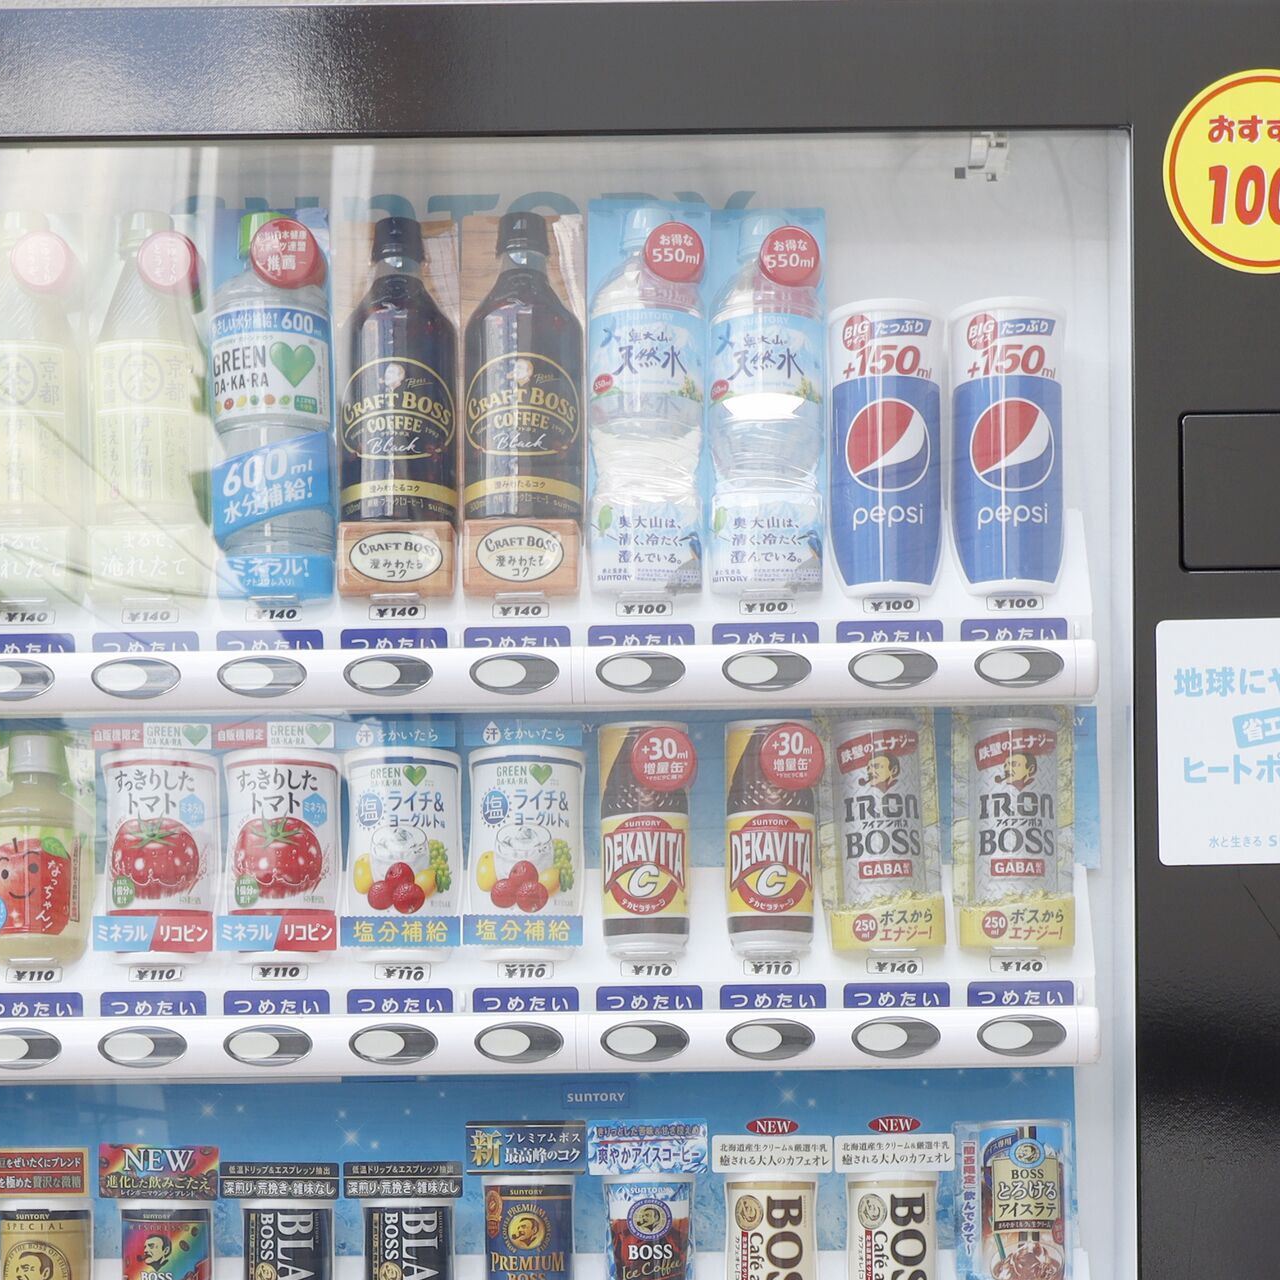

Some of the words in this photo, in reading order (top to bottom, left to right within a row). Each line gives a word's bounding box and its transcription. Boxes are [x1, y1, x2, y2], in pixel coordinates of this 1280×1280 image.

[660, 234, 693, 247] お得な
[774, 239, 807, 252] お得な
[652, 249, 699, 265] 550ml
[767, 253, 814, 268] 550ml
[843, 320, 870, 339] BIG
[876, 320, 924, 335] たっぷり
[968, 319, 995, 339] BIG
[1001, 320, 1049, 335] たっぷり
[213, 346, 266, 377] GREEN
[344, 393, 398, 424] CRAFT
[402, 392, 451, 425] BOSS
[470, 389, 522, 420] CRAFT
[528, 388, 577, 421] BOSS
[367, 417, 422, 432] COFFEE
[853, 503, 923, 531] pepsi
[978, 503, 1048, 531] pepsi
[376, 607, 418, 617] ¥140
[622, 604, 667, 615] ¥100
[995, 598, 1038, 610] ¥100
[146, 726, 180, 737] GREEN
[270, 725, 304, 736] GREEN
[114, 768, 195, 792] すっきりした
[238, 768, 318, 792] すっきりした
[370, 767, 400, 779] GREEN
[497, 766, 527, 778] GREEN
[128, 794, 176, 814] トマト
[252, 792, 300, 814] トマト
[388, 790, 444, 812] ライチ&
[516, 790, 568, 811] ライチ&
[847, 829, 920, 859] BOSS
[979, 828, 1054, 857] BOSS
[1209, 835, 1262, 848] 水と生きる
[606, 832, 684, 882] DEKAVITA
[732, 831, 811, 882] DEKAVITA
[628, 864, 660, 897] C
[756, 863, 788, 896] C
[880, 909, 933, 924] ボスから
[1010, 908, 1064, 924] ボスから
[97, 925, 148, 941] ミネラル
[160, 926, 208, 942] リコピン
[221, 924, 272, 940] ミネラル
[284, 925, 332, 941] リコピン
[353, 921, 448, 942] 塩分補給
[476, 920, 570, 941] 塩分補給
[606, 995, 692, 1010] つめたい
[977, 990, 1064, 1006] つめたい
[233, 999, 320, 1015] つめたい
[567, 1092, 625, 1103] SUNTORY
[756, 1120, 790, 1133] NEW
[877, 1118, 912, 1131] NEW
[471, 1130, 501, 1167] 新
[505, 1147, 579, 1164] 最高峰のコク
[599, 1148, 700, 1166] 爽やかアイスコーヒー
[124, 1149, 194, 1172] NEW
[720, 1154, 830, 1166] 癒される大人のカフェオレ
[842, 1153, 951, 1165] 癒される大人のカフェオレ
[1011, 1169, 1044, 1180] BOSS
[106, 1176, 210, 1191] 進化した飲みごたえ
[998, 1182, 1056, 1200] とろける
[998, 1203, 1056, 1218] アイスラテ
[260, 1213, 273, 1261] BOSS
[384, 1213, 399, 1260] BOSS
[628, 1245, 672, 1261] BOSS
[750, 1232, 764, 1269] Café
[874, 1231, 888, 1268] Café
[491, 1252, 564, 1272] PREMIUM
